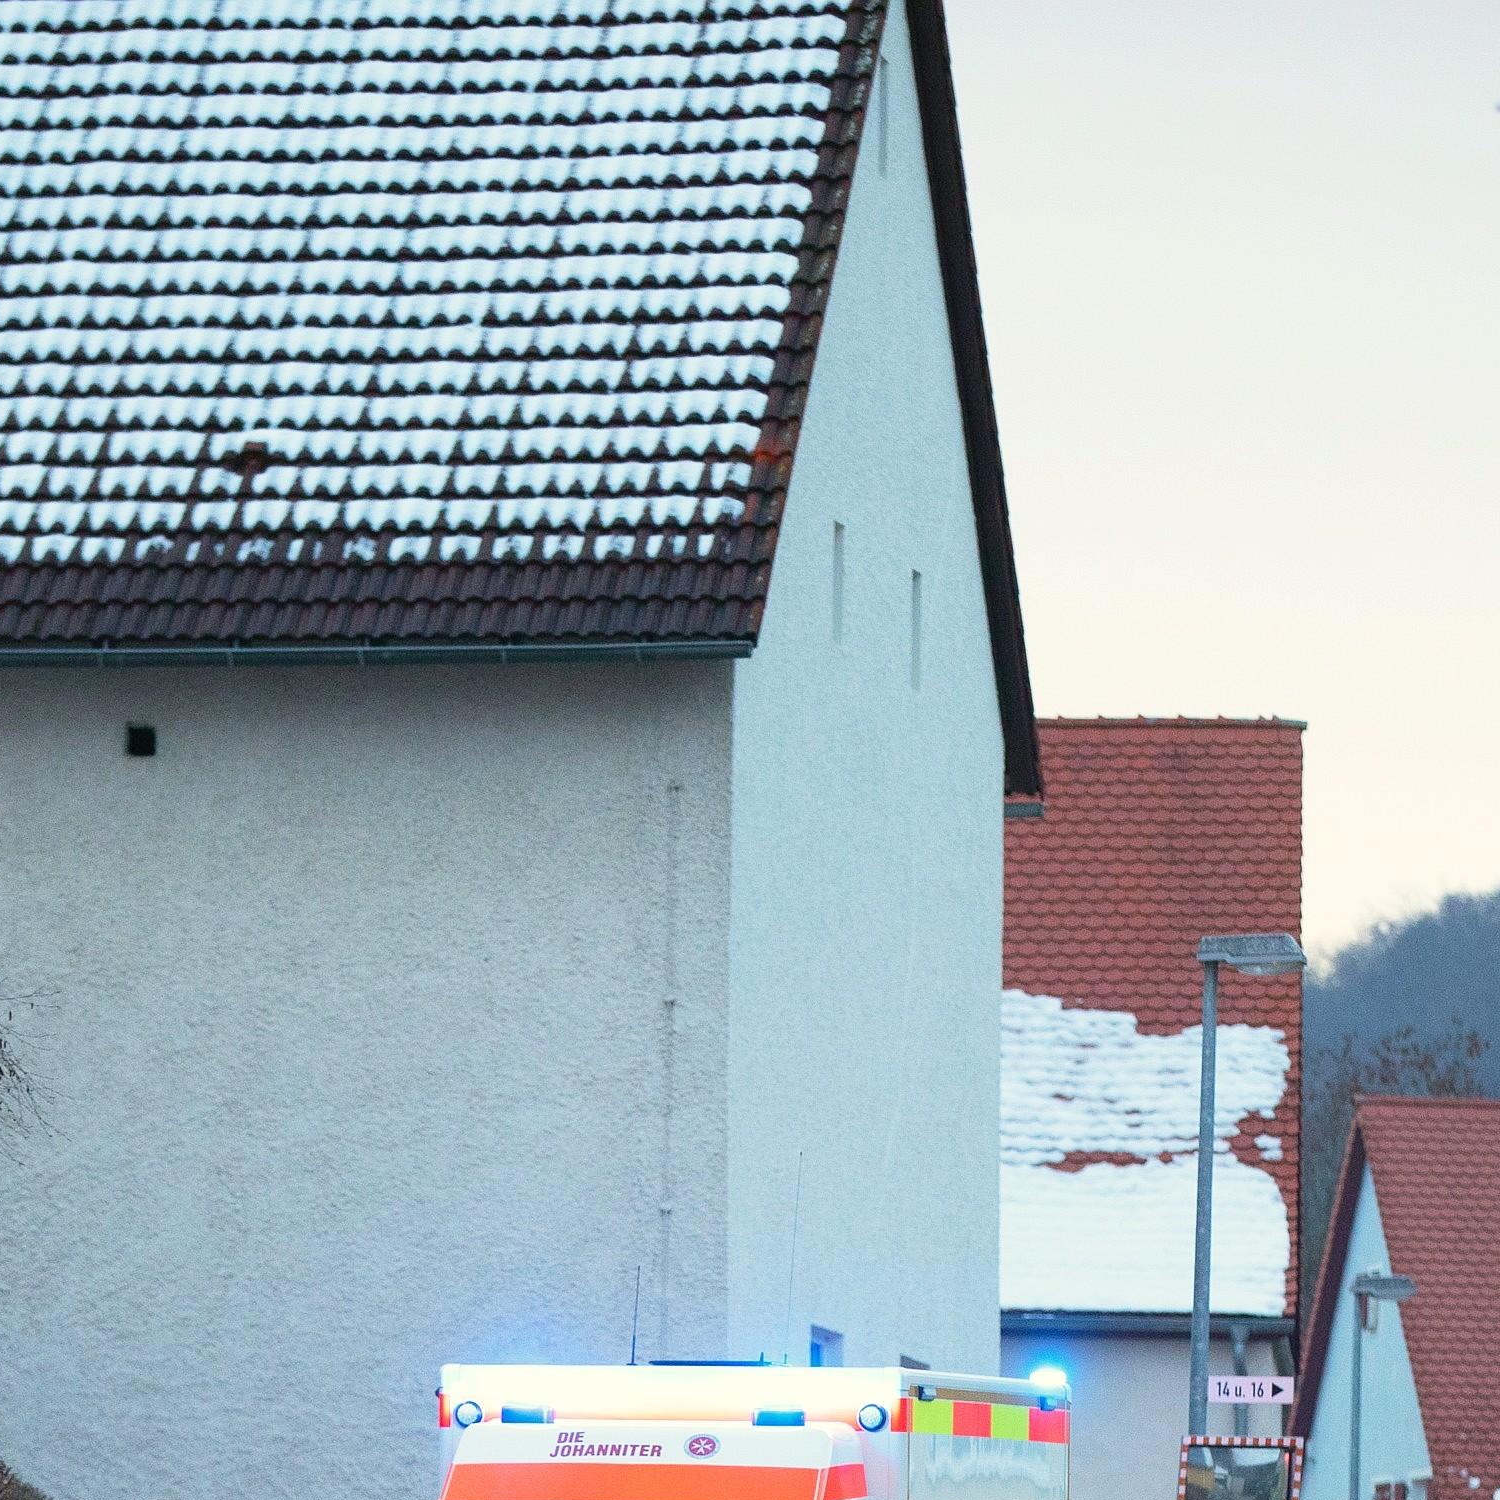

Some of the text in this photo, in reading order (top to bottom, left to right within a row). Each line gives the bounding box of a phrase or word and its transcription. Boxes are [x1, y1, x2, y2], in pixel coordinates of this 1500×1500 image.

[1218, 1382, 1264, 1398] 14 u. 16
[557, 1431, 585, 1444] DIE
[550, 1443, 663, 1458] JOHANNITER
